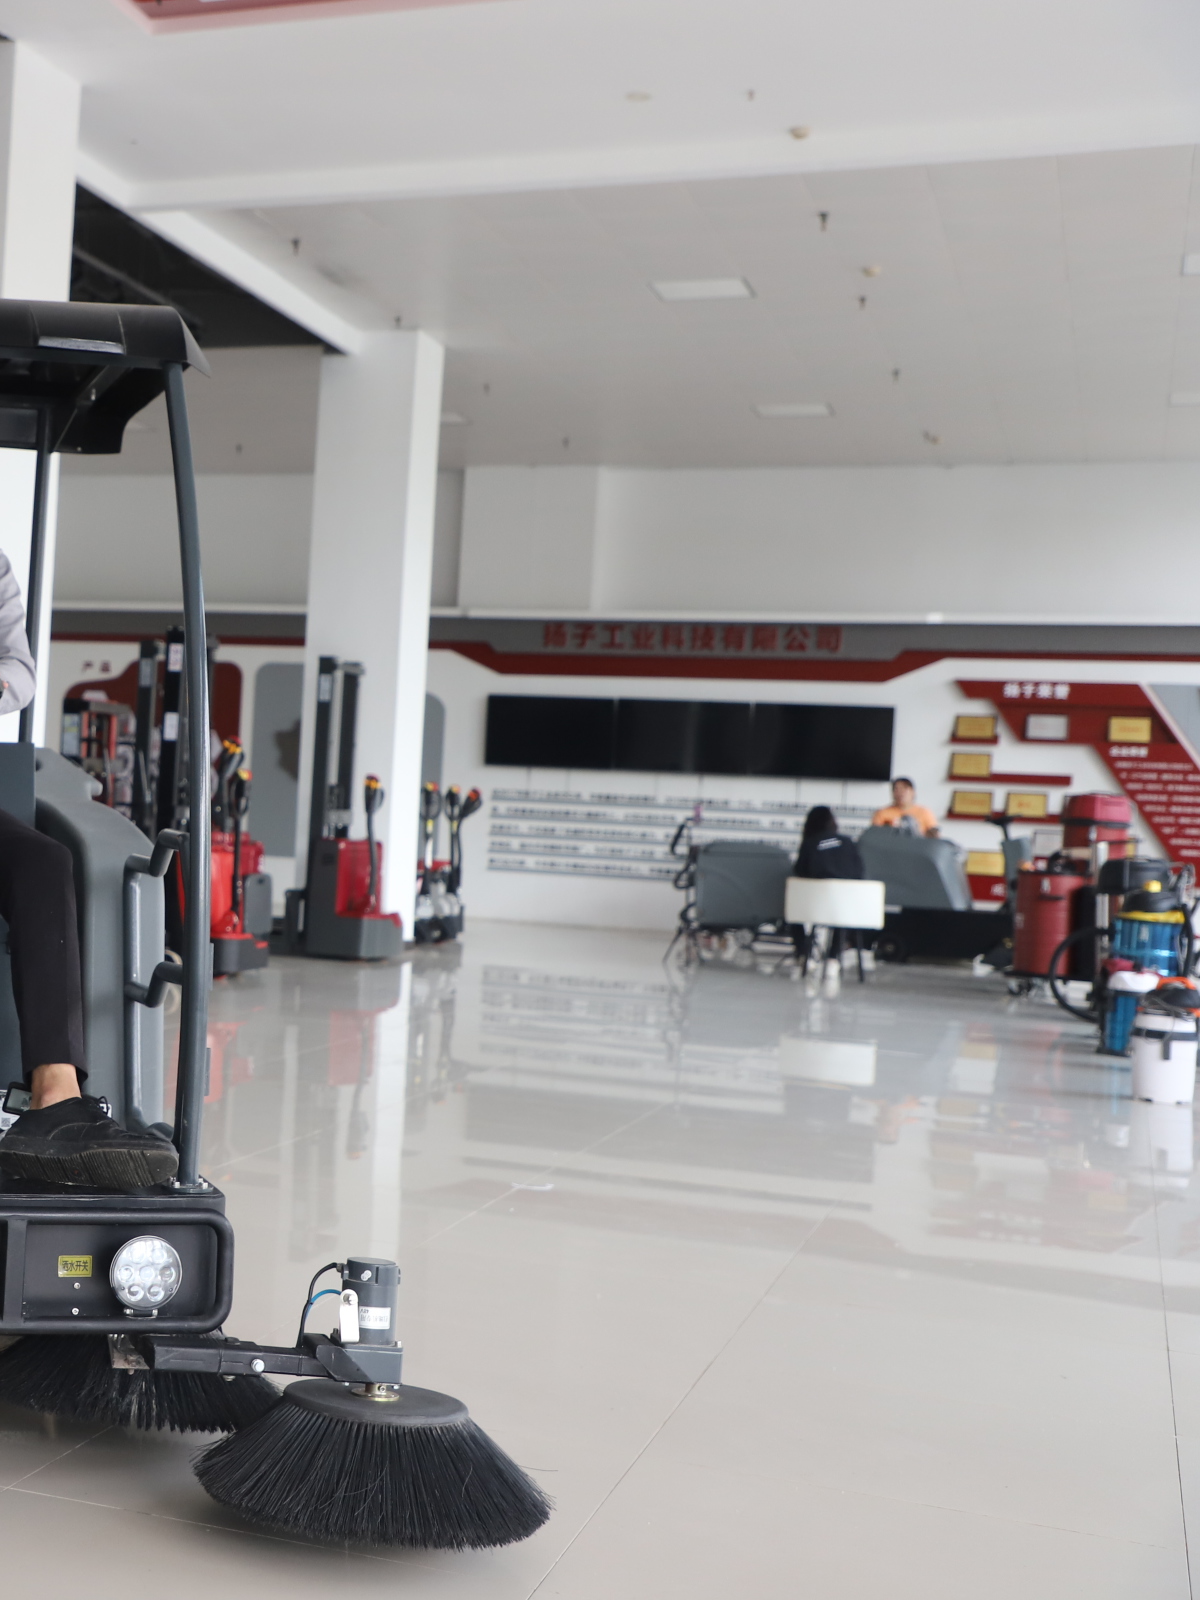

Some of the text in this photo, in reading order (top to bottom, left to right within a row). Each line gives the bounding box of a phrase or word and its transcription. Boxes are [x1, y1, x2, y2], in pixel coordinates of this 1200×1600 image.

[543, 622, 843, 653] 扬子工业科技有限公司
